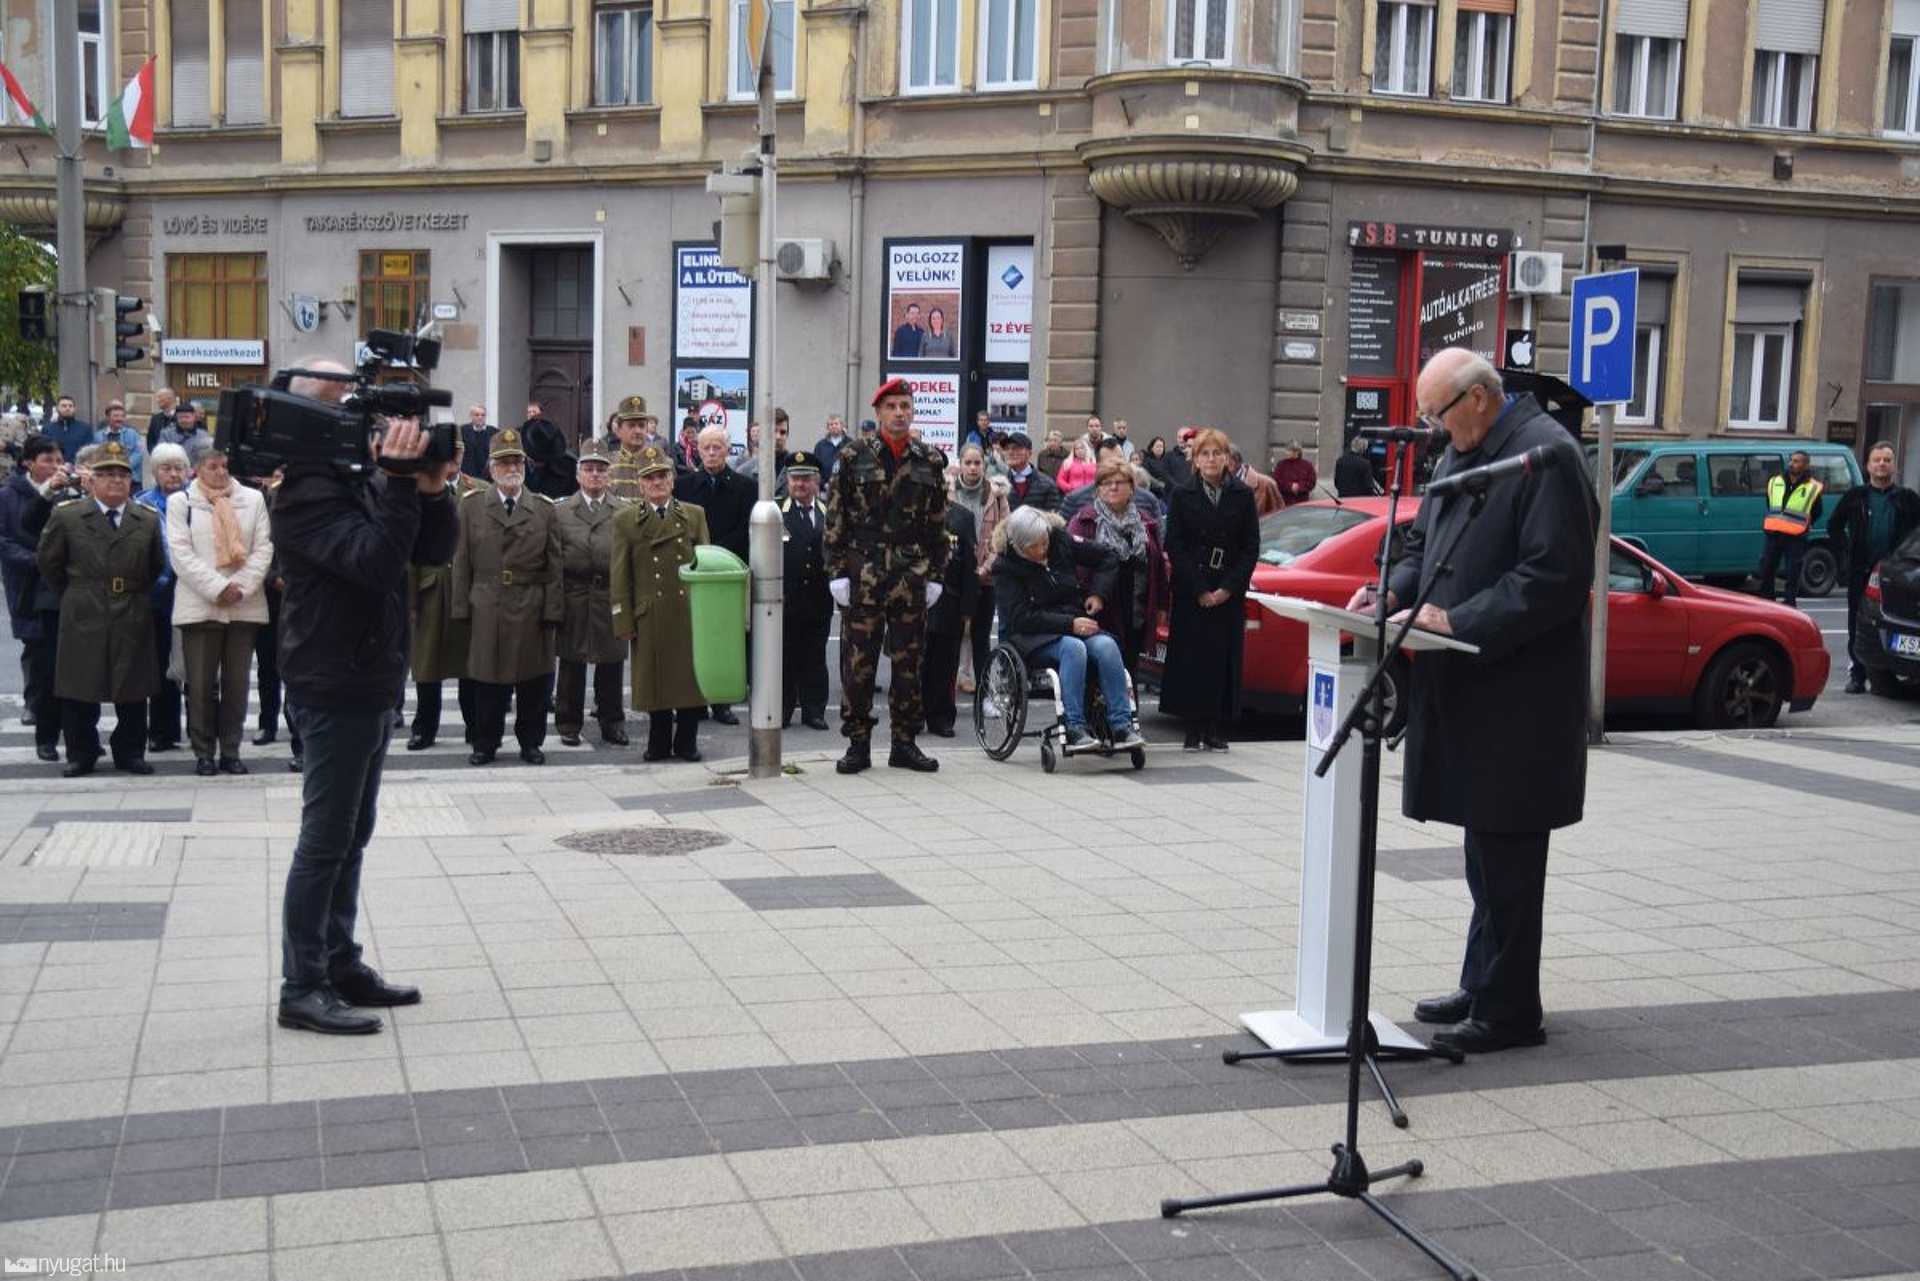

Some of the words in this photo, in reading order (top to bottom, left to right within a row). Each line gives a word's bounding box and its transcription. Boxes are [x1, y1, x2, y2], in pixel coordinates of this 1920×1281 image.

[201, 216, 218, 234] ÉS
[222, 216, 268, 234] VIDÉKE
[1415, 230, 1499, 248] TUNING
[682, 255, 721, 267] ELIND
[893, 252, 960, 264] DOLGOZZ
[682, 272, 693, 284] A
[896, 268, 956, 282] VELÜNK!
[1419, 272, 1501, 324] AUTÓALKATRÉSZ
[1457, 312, 1465, 326] &
[989, 323, 1003, 334] 12
[1443, 321, 1485, 344] TUNING
[1582, 295, 1621, 384] P
[165, 347, 261, 359] takarékszövetkezet
[186, 373, 220, 388] HITEL
[908, 381, 956, 393] DEKEL
